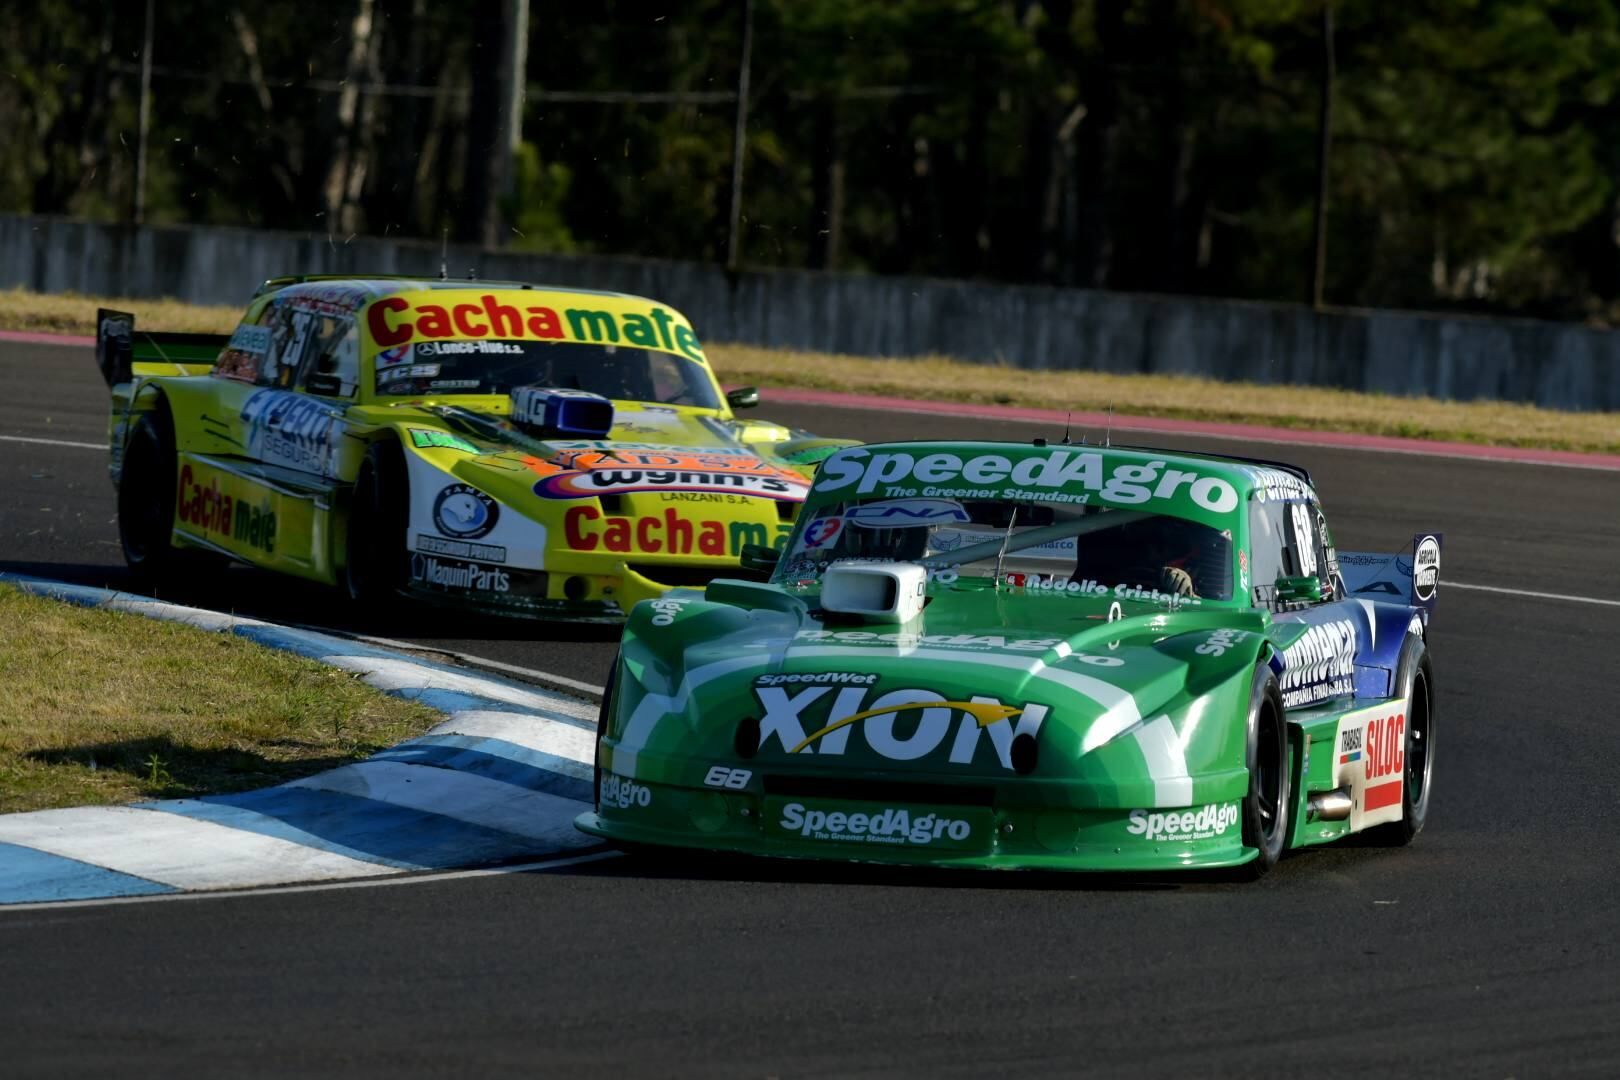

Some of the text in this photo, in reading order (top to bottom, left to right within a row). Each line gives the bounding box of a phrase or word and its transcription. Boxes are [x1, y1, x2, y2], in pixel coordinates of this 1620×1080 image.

[366, 295, 704, 363] Cachamate
[814, 449, 1238, 514] SpeedAgro
[660, 493, 723, 503] LANZANI
[884, 485, 1089, 504] The Greener Standard
[1026, 574, 1108, 594] Rodolfo
[756, 672, 877, 685] SpeedWet
[756, 686, 1050, 769] XION
[703, 766, 753, 789] 68
[779, 803, 970, 844] SpeedAgro
[1126, 803, 1238, 840] SpeedAgro
[831, 832, 865, 842] Greener
[866, 834, 905, 844] Standard
